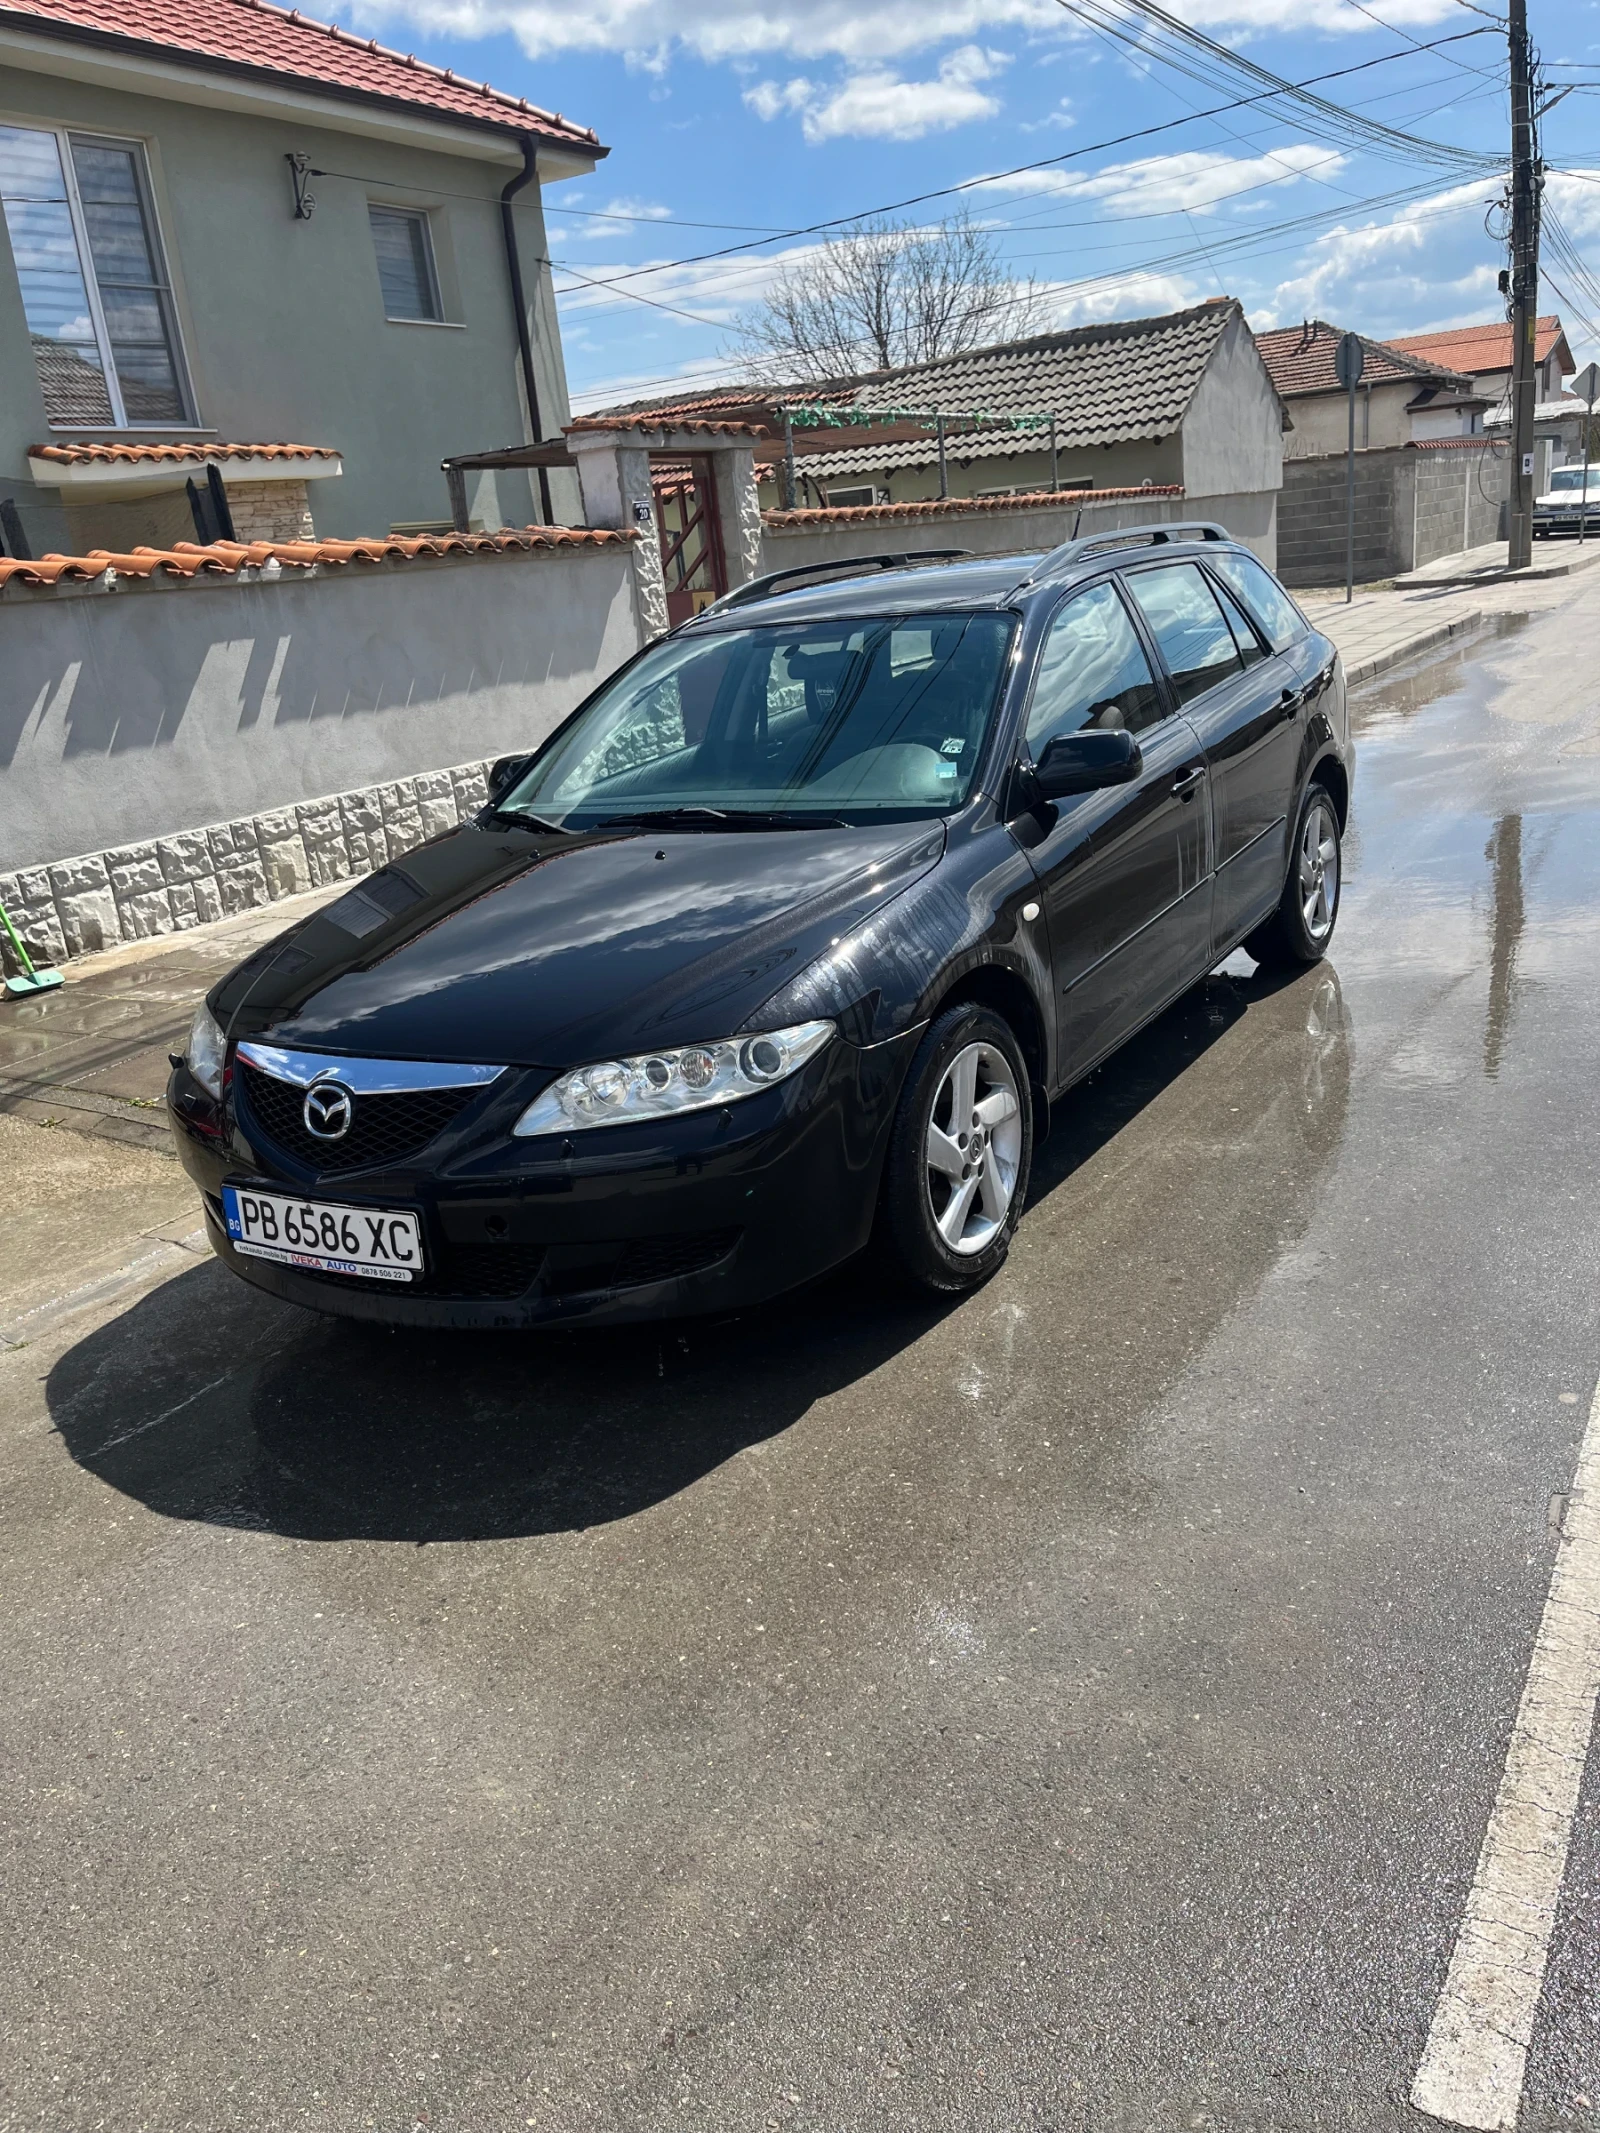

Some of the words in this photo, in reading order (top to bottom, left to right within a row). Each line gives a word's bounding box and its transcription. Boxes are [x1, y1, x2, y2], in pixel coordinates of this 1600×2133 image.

[640, 508, 649, 520] 20
[228, 1218, 241, 1231] BG
[241, 1197, 279, 1241] PB
[285, 1205, 360, 1255] 6586
[365, 1217, 413, 1262] XC
[291, 1253, 322, 1268] IVEKA
[326, 1260, 357, 1273] AUTO
[361, 1267, 378, 1277] 0878
[379, 1269, 392, 1279] 506
[393, 1271, 406, 1280] 221
